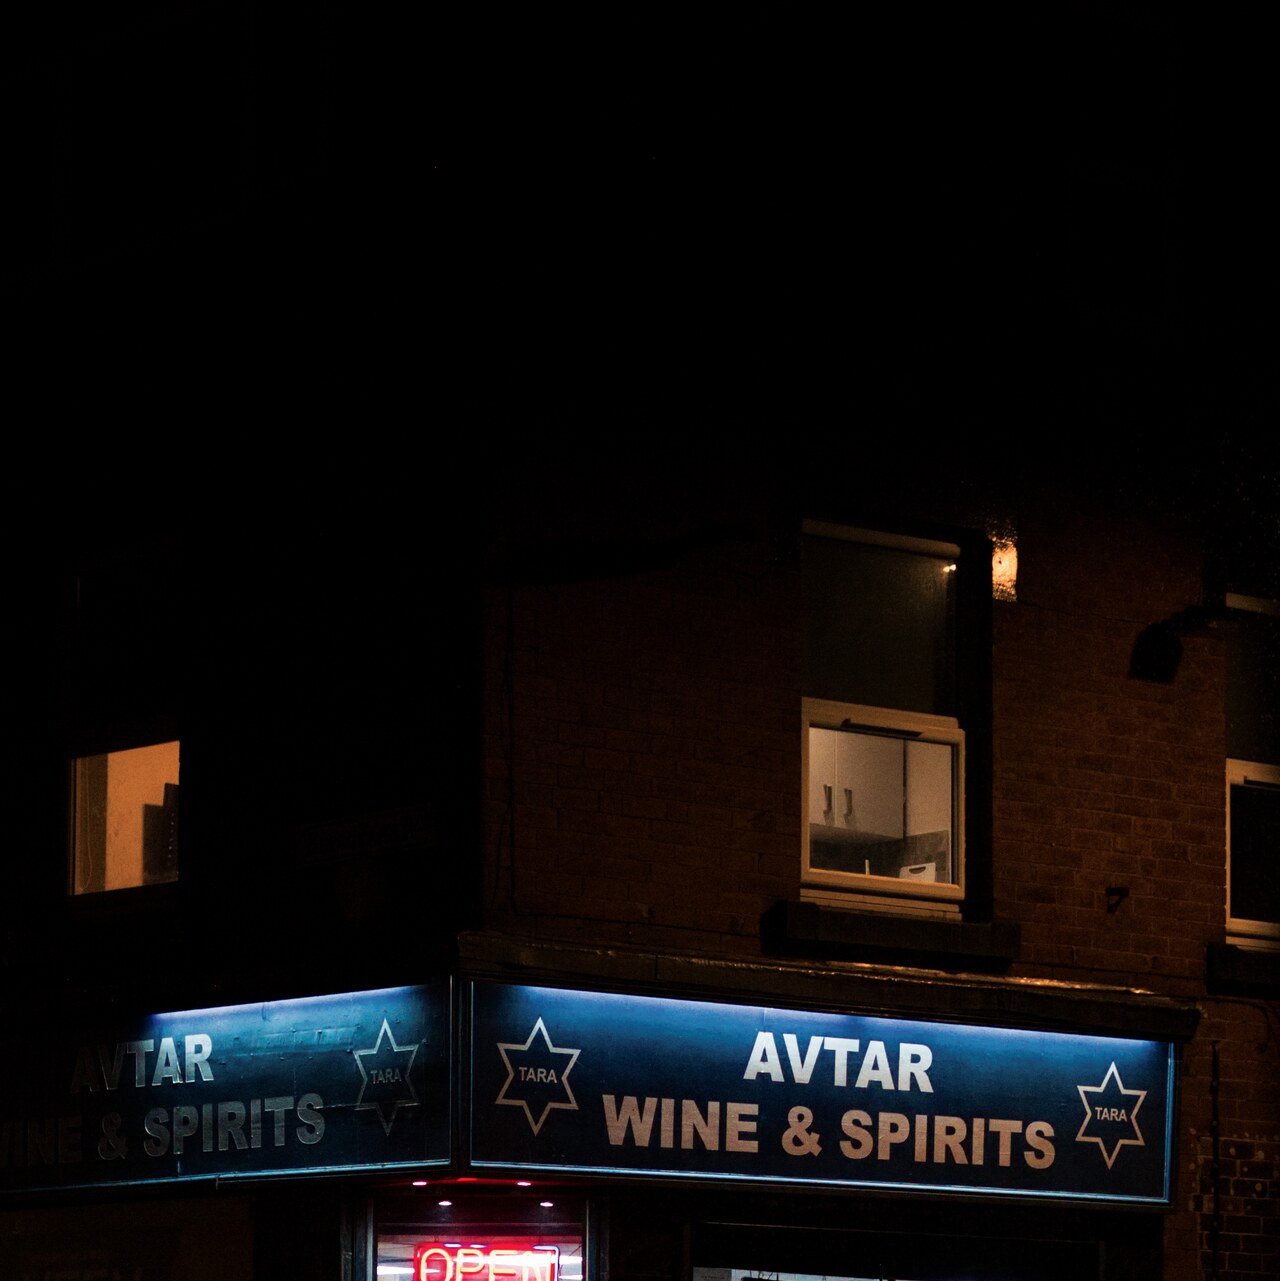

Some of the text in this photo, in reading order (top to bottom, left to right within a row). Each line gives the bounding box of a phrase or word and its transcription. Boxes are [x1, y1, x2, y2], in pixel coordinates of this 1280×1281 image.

[71, 1033, 215, 1095] AVTAR
[370, 1067, 402, 1086] TARA
[519, 1067, 558, 1084] TARA
[743, 1031, 935, 1094] AVTAR
[96, 1112, 129, 1161] &
[142, 1092, 328, 1159] SPIRITS
[602, 1094, 1056, 1170] WINE & SPIRITS
[1095, 1107, 1128, 1122] TARA
